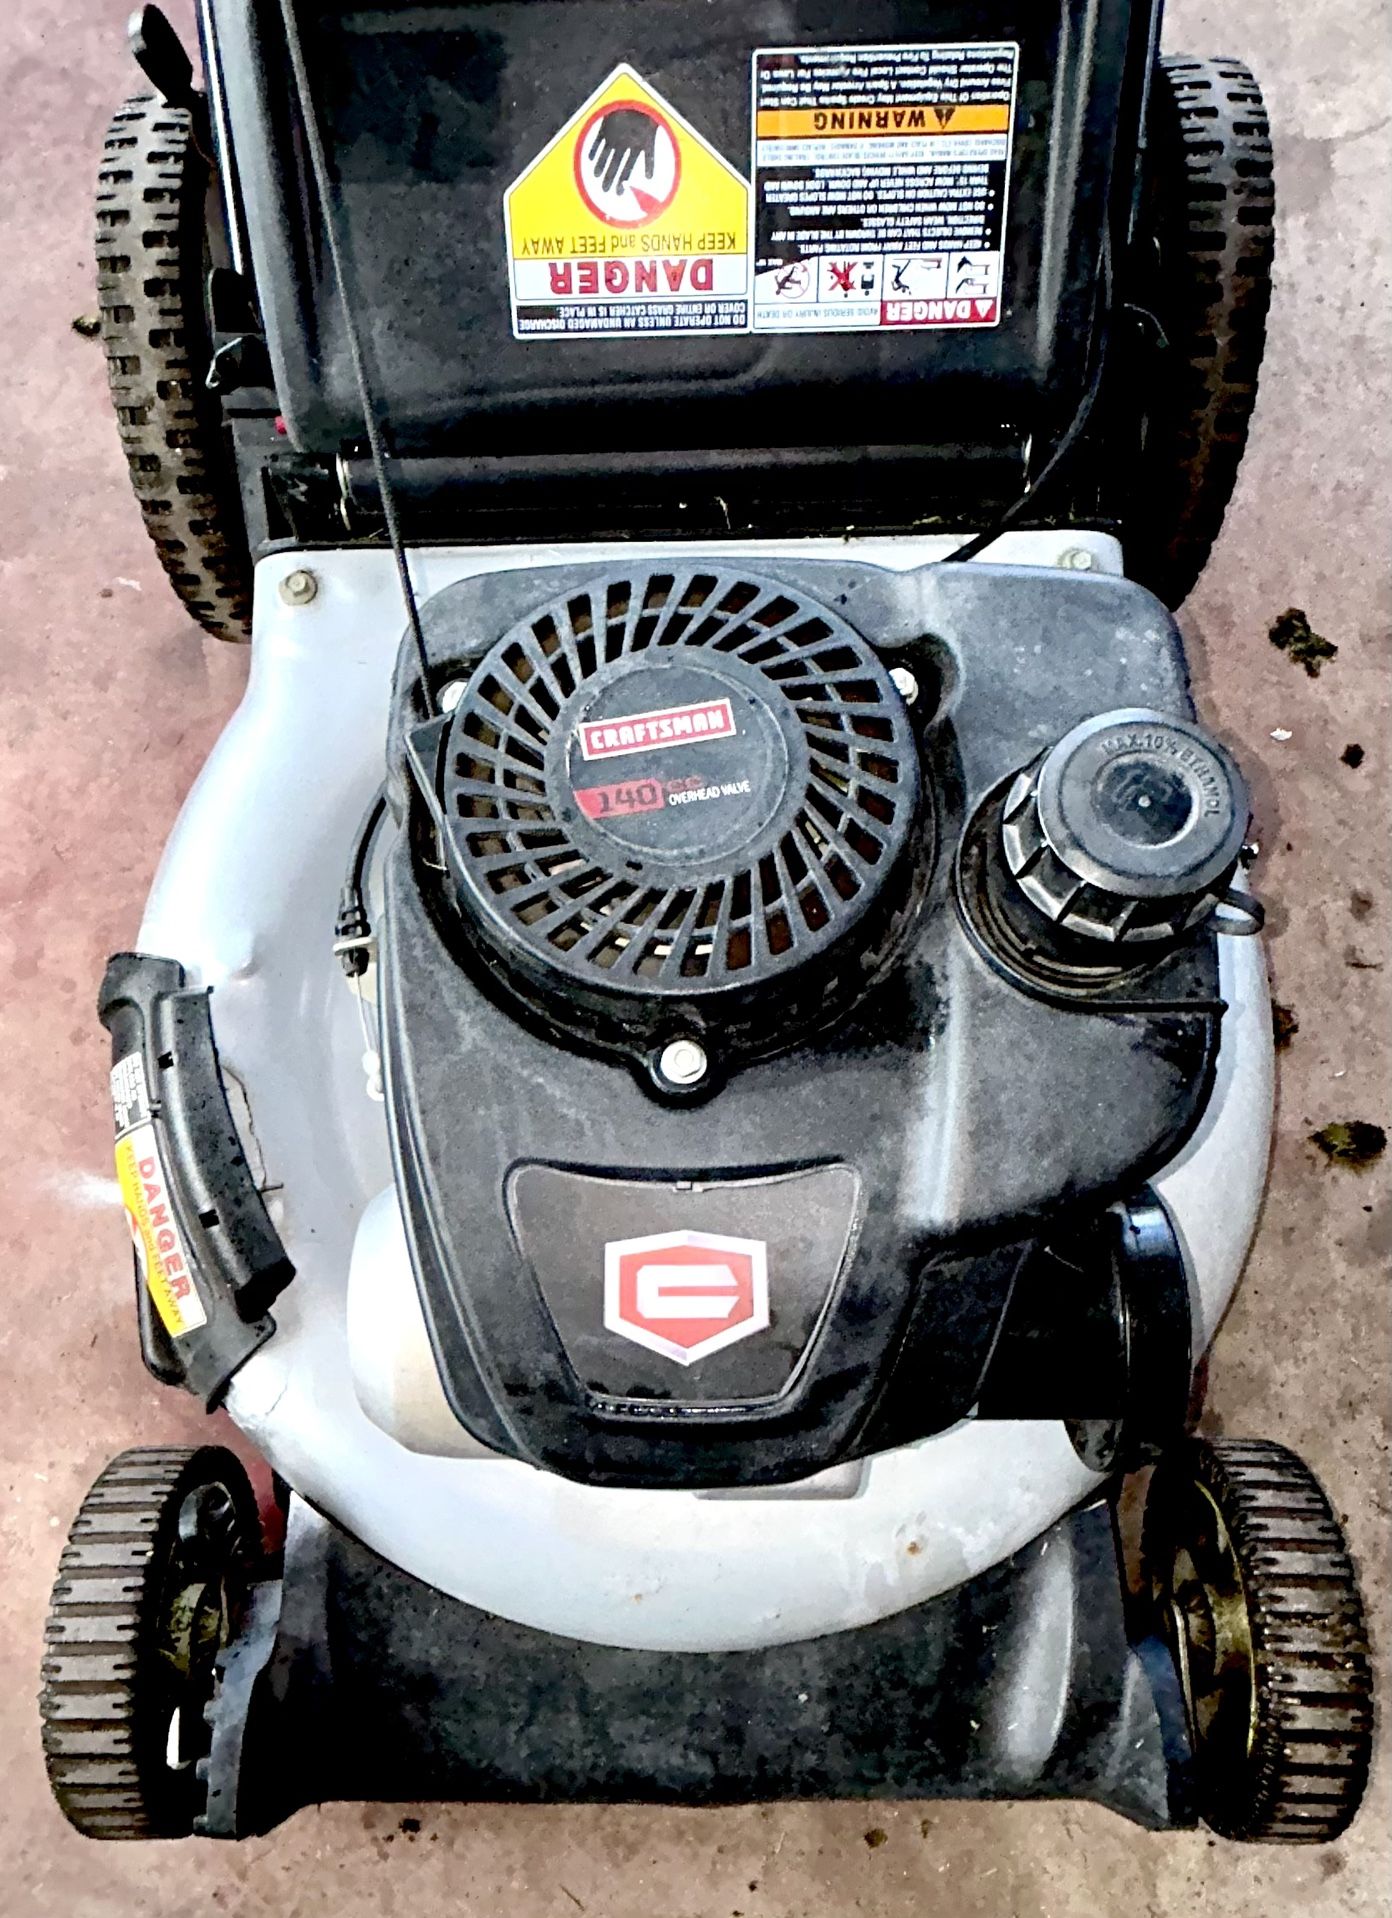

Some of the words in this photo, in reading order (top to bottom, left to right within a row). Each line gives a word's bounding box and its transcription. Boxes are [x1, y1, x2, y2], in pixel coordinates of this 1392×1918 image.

[814, 110, 926, 130] WARNING
[521, 237, 564, 255] AWAY
[570, 236, 606, 254] FEET
[611, 235, 636, 253] and
[642, 234, 693, 252] HANDS
[698, 233, 736, 250] KEEP
[548, 258, 714, 295] DANGER
[556, 306, 585, 318] PLACE.
[587, 305, 597, 317] IN
[598, 305, 607, 316] IS
[609, 304, 646, 316] CATCHER
[648, 303, 674, 315] GRASS
[675, 303, 702, 314] ENTIRE
[704, 302, 716, 314] OR
[718, 302, 745, 313] COVER
[756, 311, 780, 319] DEATH
[886, 300, 971, 320] DANGER
[519, 319, 566, 331] DISCHARGE
[568, 317, 622, 330] UNDAMAGED
[624, 317, 636, 328] AN
[638, 316, 672, 328] UNLESS
[673, 314, 712, 326] OPERATE
[713, 314, 731, 325] NOT
[733, 313, 745, 325] DO
[590, 710, 724, 748] CRAFTSMAN
[598, 784, 657, 814] 140
[669, 786, 721, 806] OVERHEAD
[722, 780, 751, 796] VALVE
[125, 1146, 141, 1180] KEEP
[131, 1182, 150, 1225] HANDS
[137, 1155, 192, 1301] DANGER
[142, 1228, 156, 1252] and
[150, 1254, 168, 1284] FEET
[162, 1286, 183, 1326] AWAY
